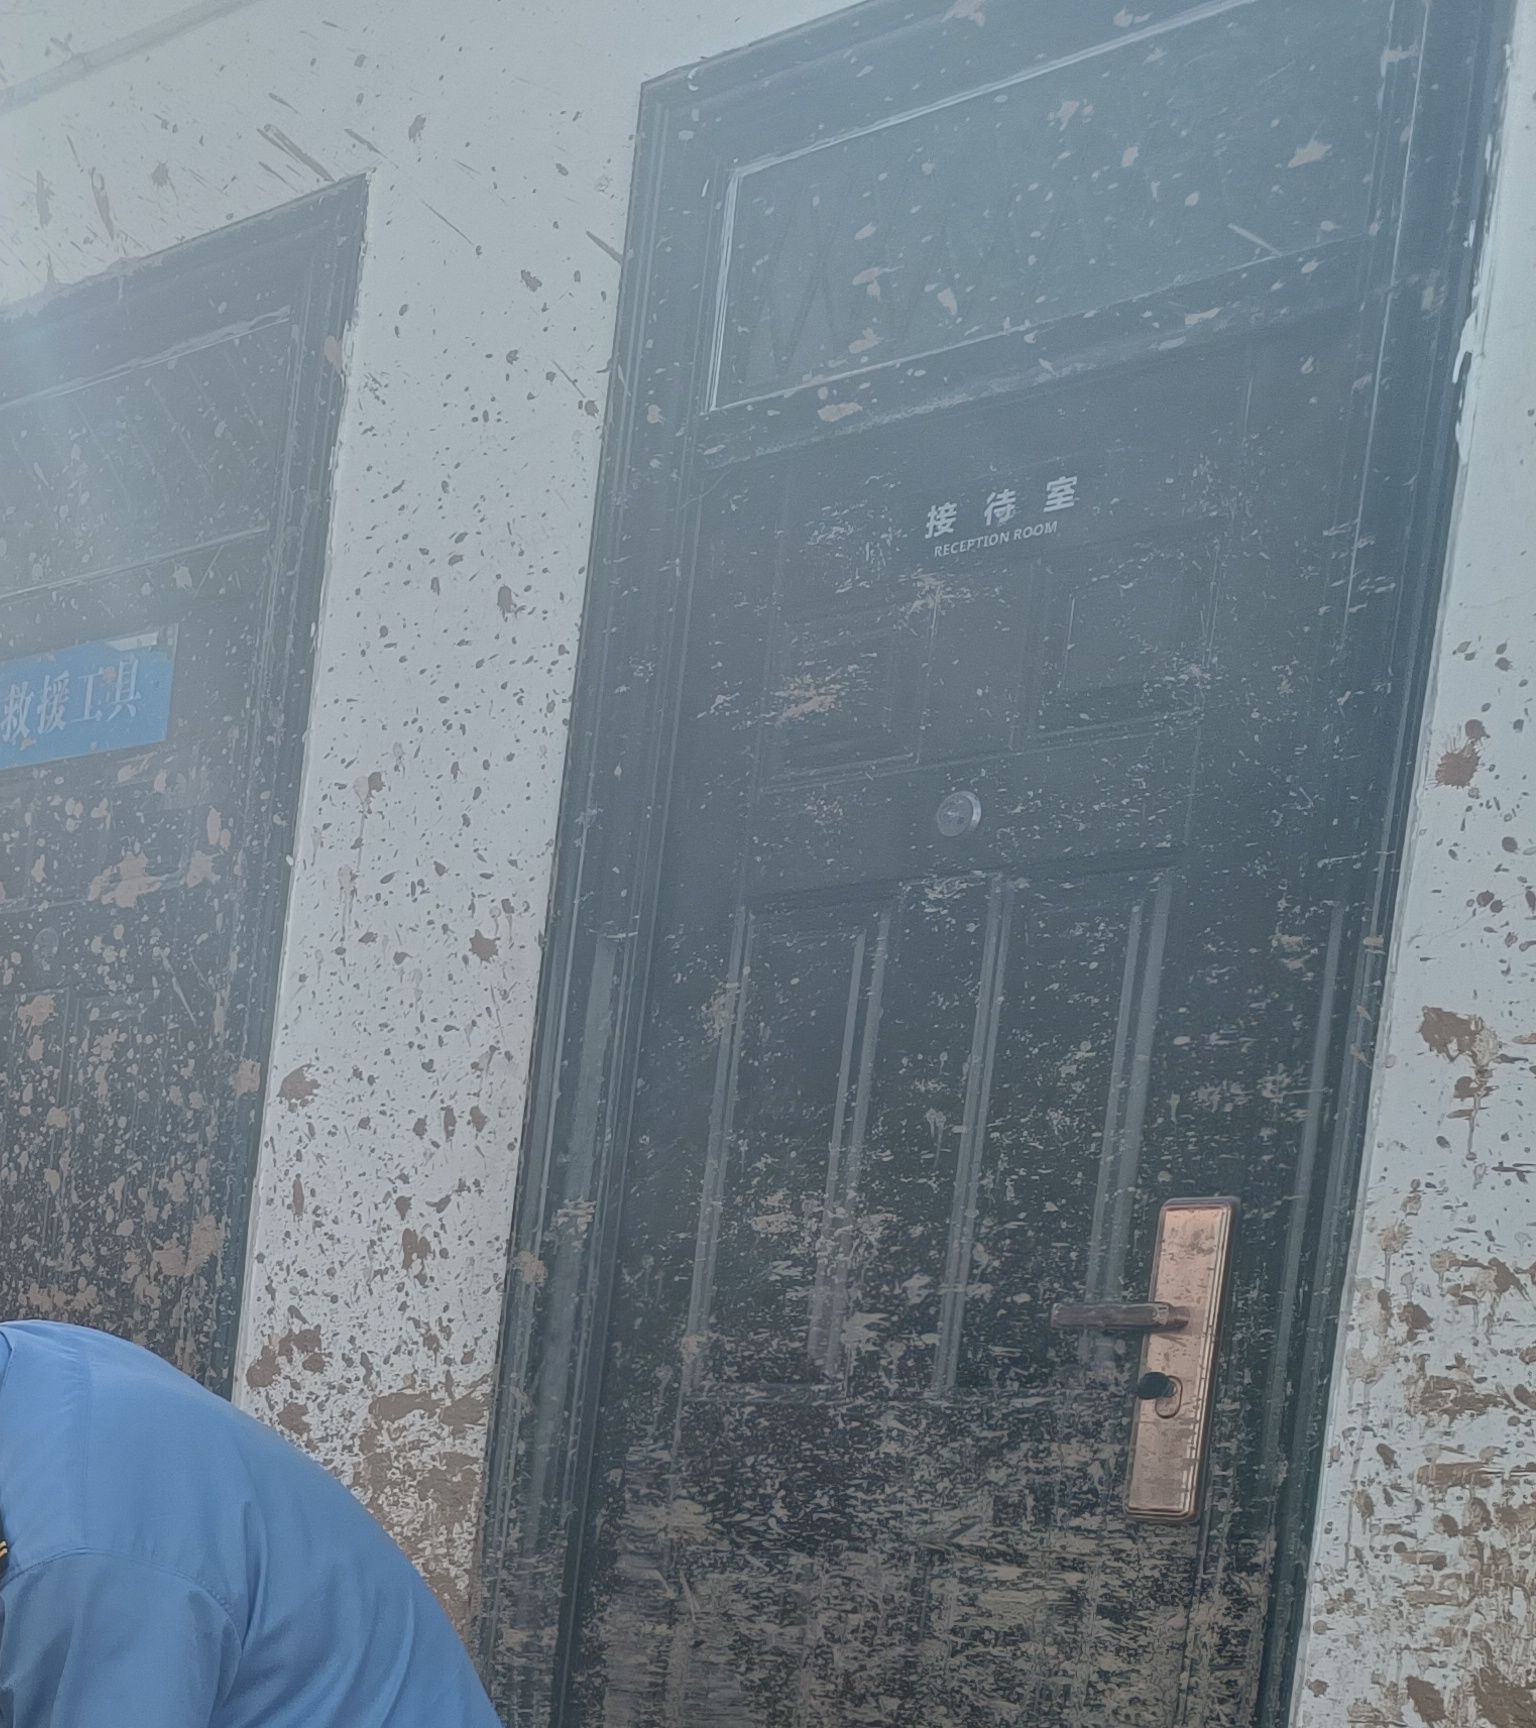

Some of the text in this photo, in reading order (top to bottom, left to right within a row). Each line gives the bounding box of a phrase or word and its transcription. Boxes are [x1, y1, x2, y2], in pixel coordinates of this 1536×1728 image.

[925, 475, 1079, 539] 接待室
[933, 520, 1059, 557] RECEPTION ROOM
[0, 653, 141, 744] 救援工具
